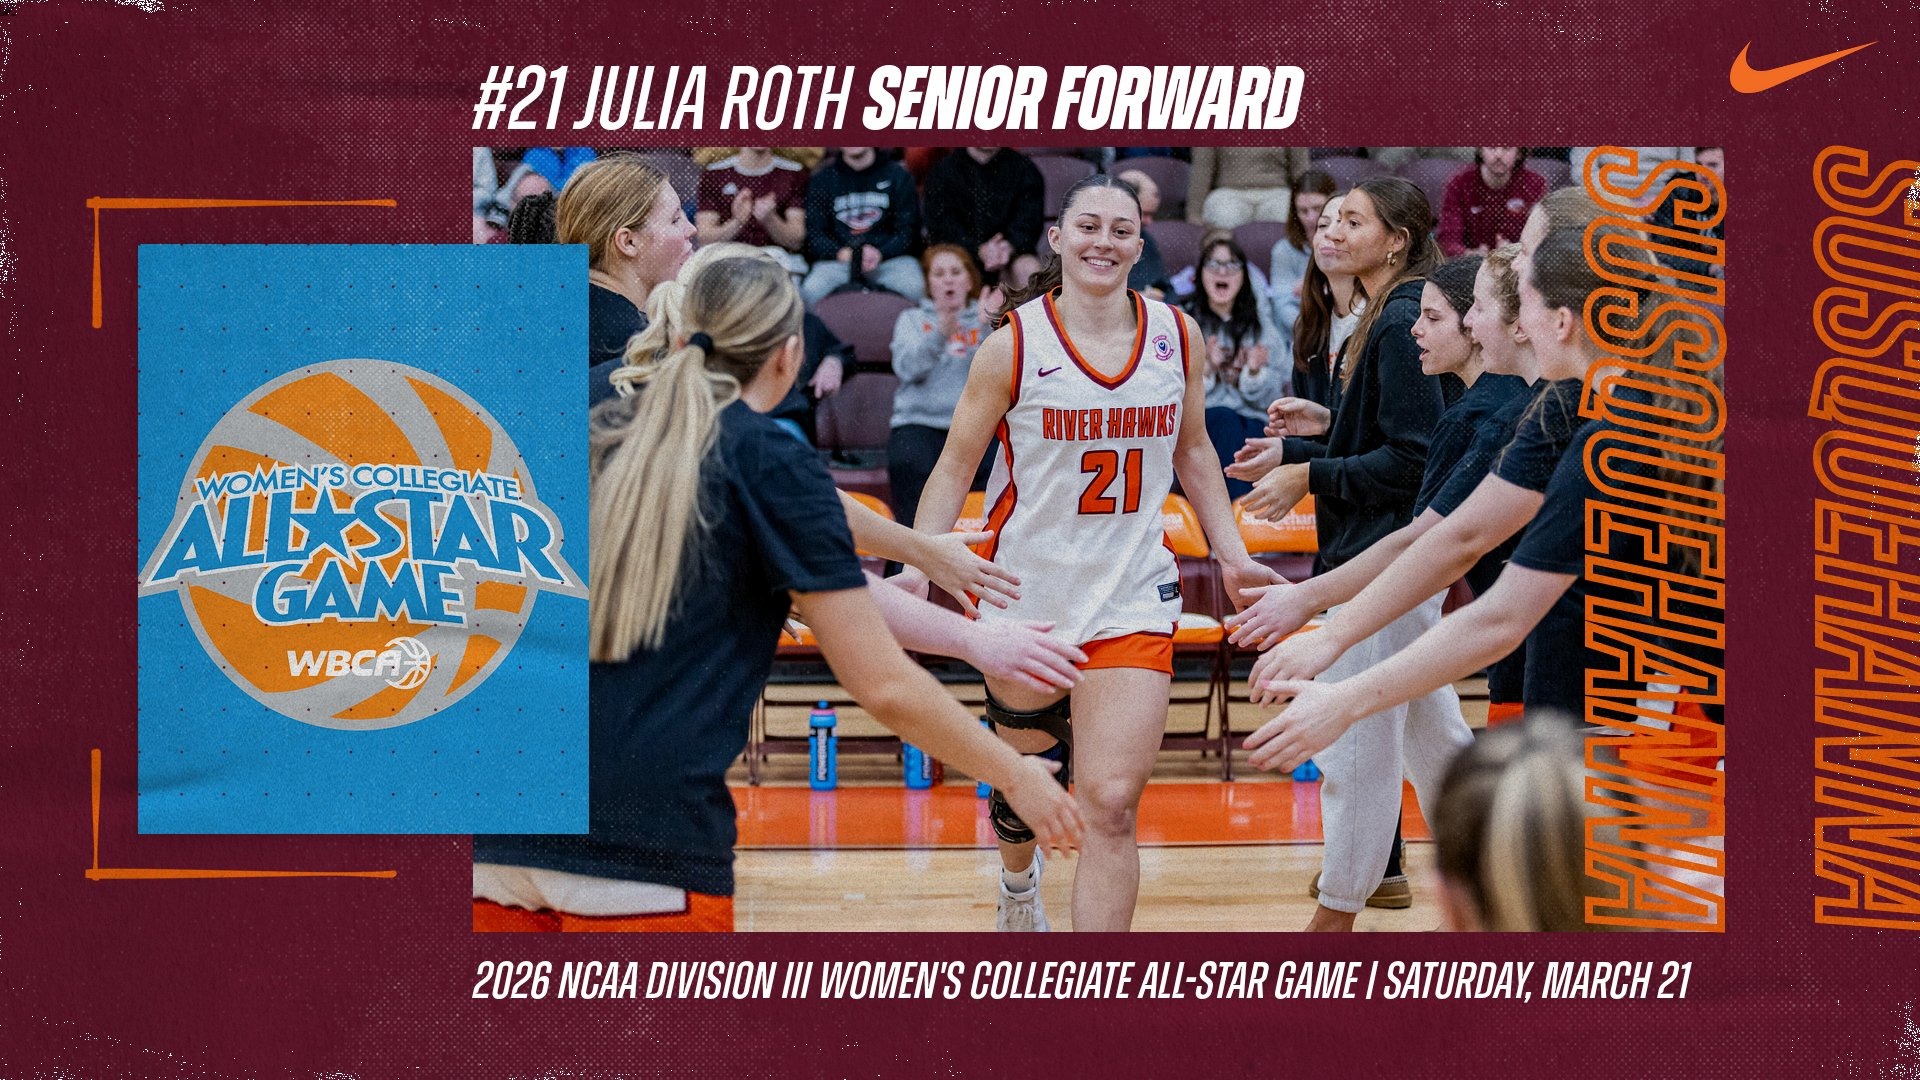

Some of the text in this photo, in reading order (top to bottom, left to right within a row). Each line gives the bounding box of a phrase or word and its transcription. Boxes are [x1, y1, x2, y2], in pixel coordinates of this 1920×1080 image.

[1042, 403, 1177, 441] RIVER HAWKS
[1078, 448, 1144, 515] 21
